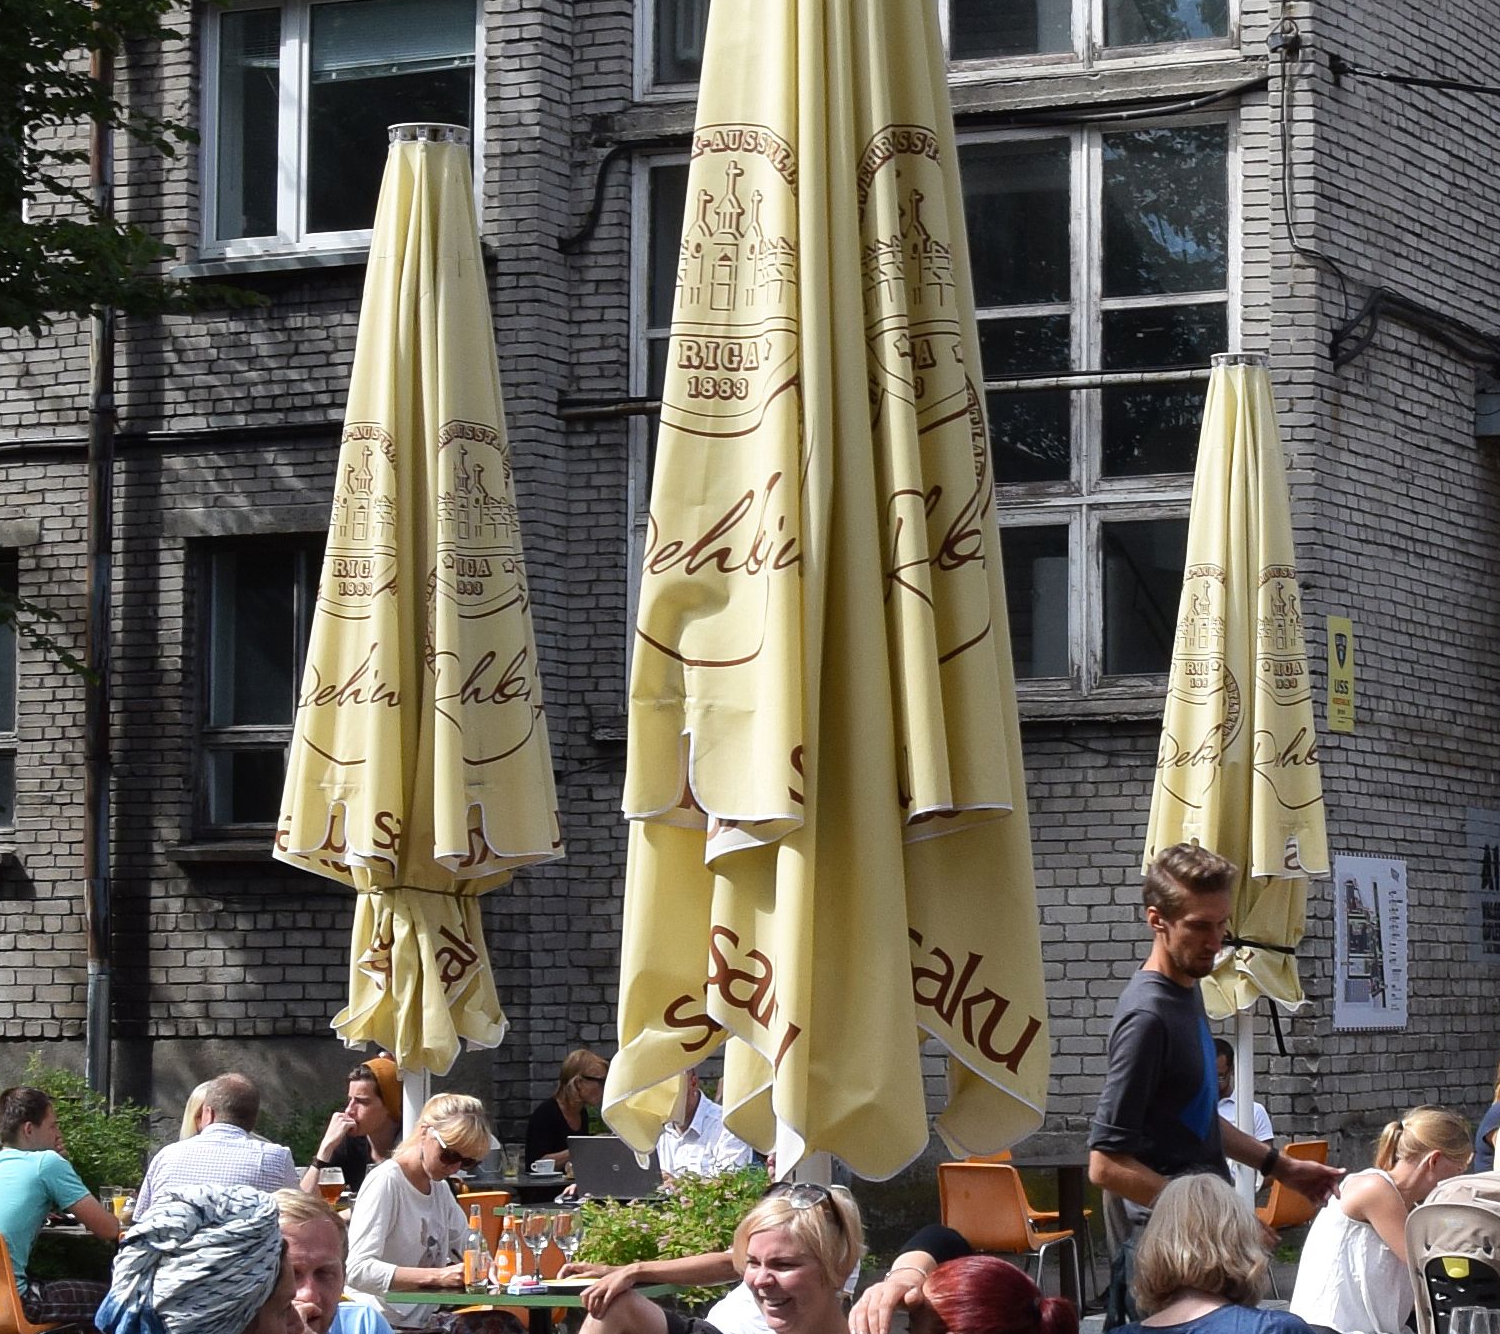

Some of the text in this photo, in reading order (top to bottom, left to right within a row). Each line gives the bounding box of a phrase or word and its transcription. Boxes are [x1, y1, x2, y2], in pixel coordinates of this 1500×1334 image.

[677, 339, 760, 372] RIGA
[687, 376, 749, 400] 1883
[1335, 679, 1348, 695] USS
[1481, 844, 1499, 891] A1
